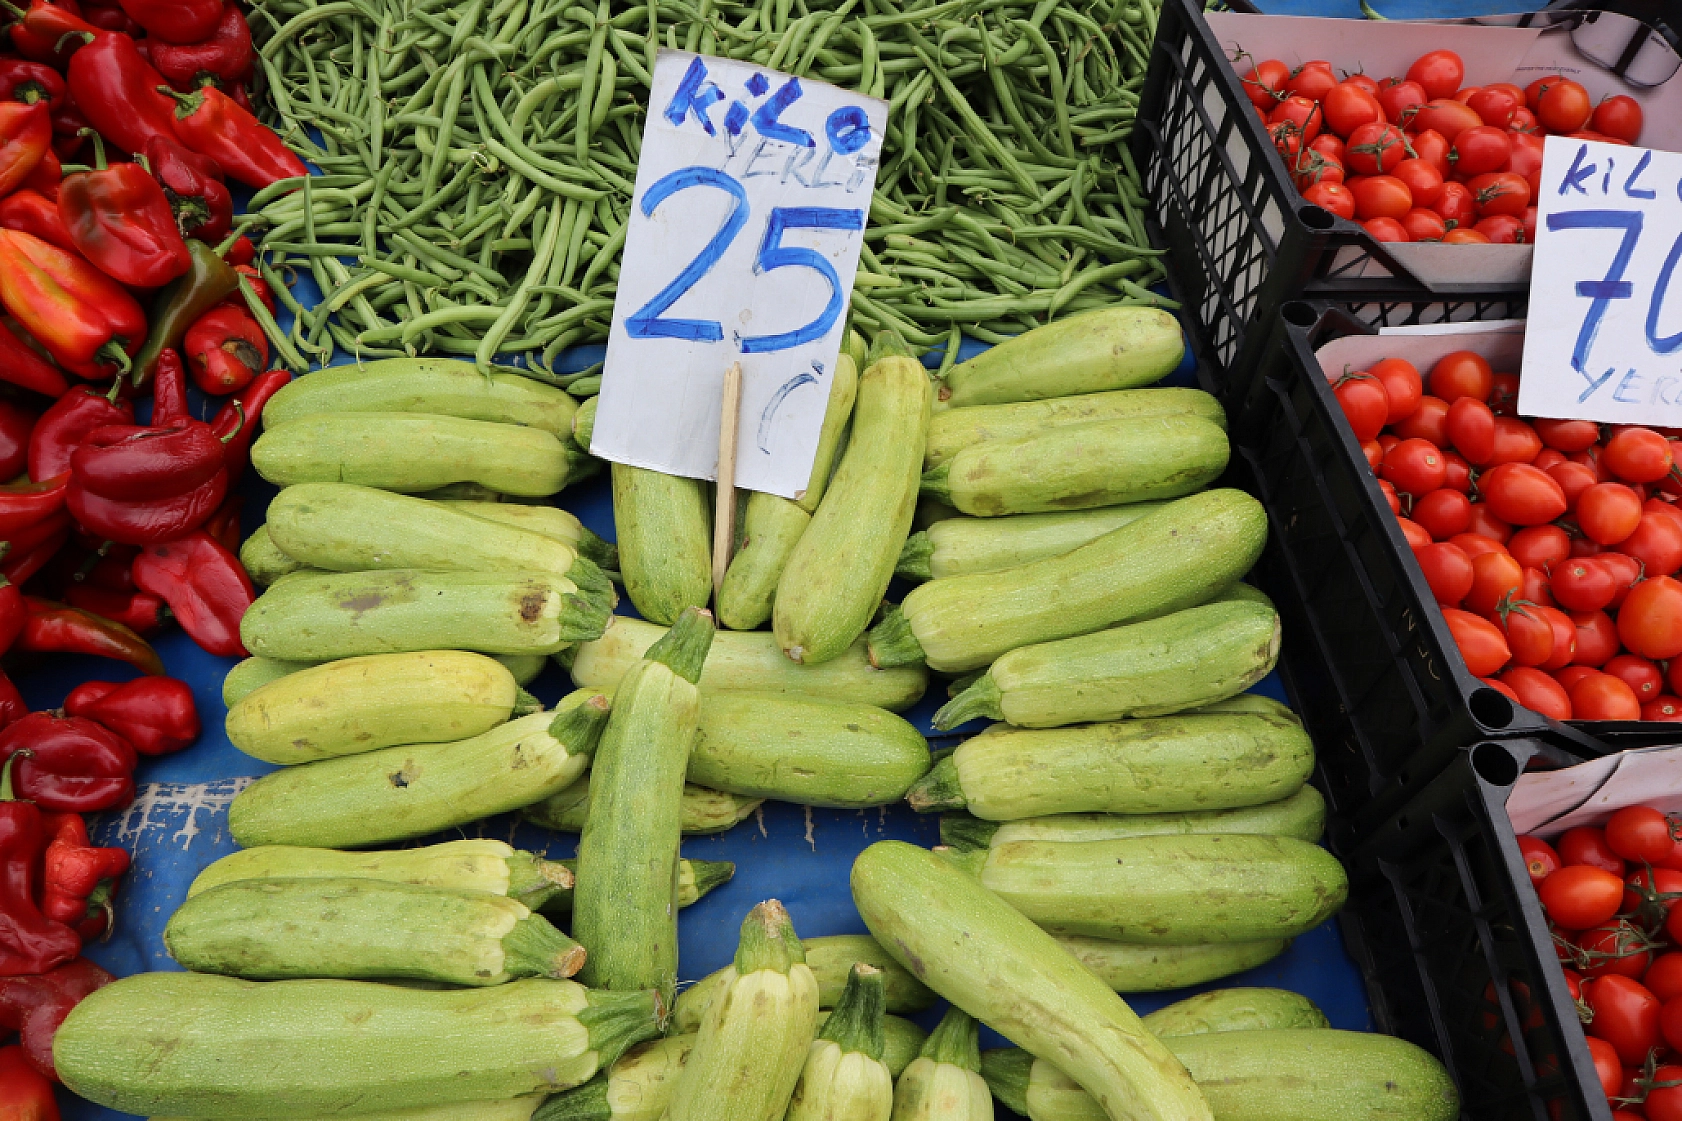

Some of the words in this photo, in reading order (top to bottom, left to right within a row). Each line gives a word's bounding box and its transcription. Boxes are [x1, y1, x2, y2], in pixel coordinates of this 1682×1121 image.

[1558, 143, 1682, 202] kiL
[624, 166, 863, 353] 25
[1577, 366, 1682, 405] YER
